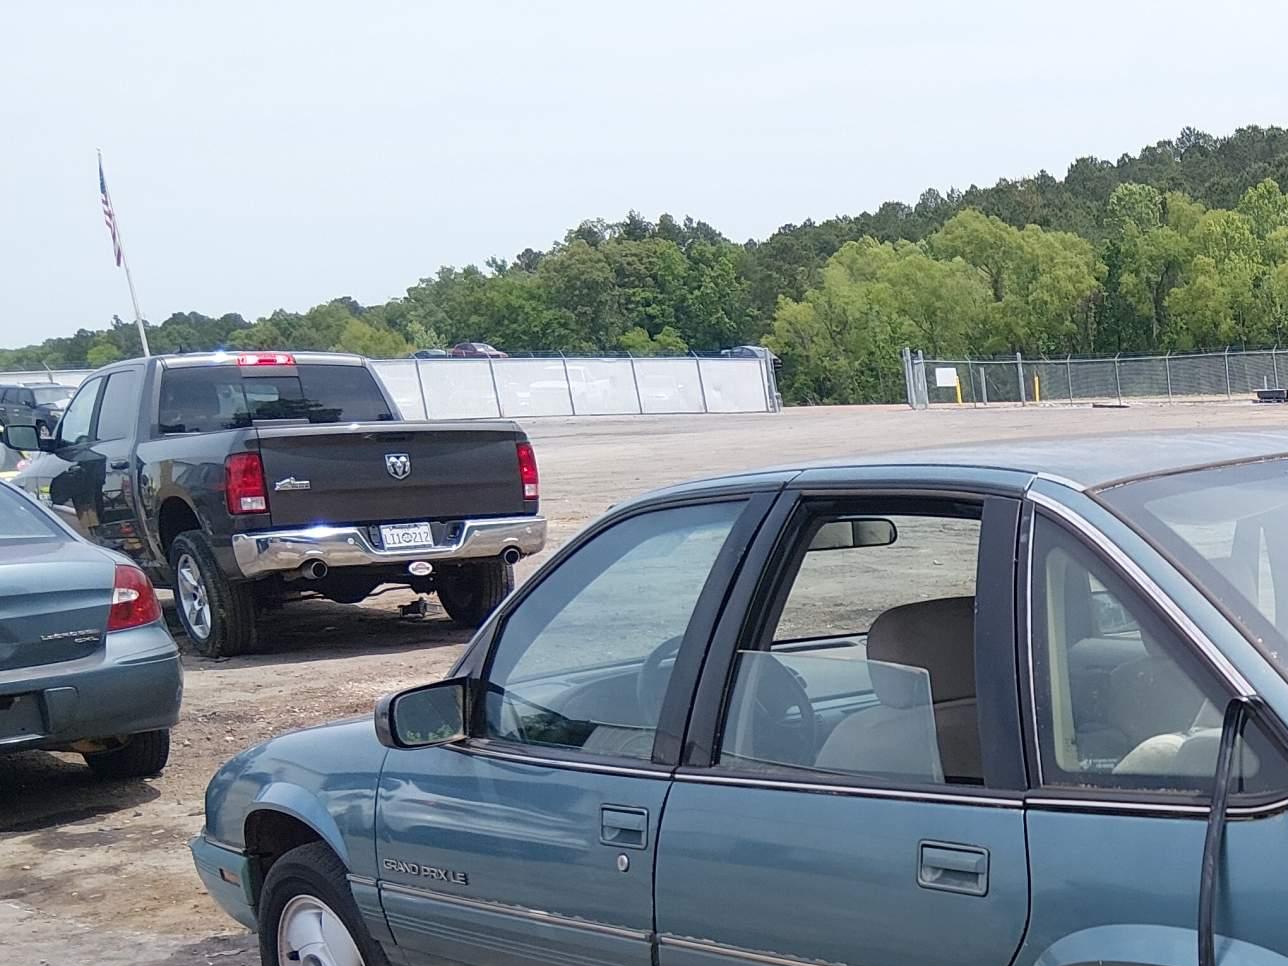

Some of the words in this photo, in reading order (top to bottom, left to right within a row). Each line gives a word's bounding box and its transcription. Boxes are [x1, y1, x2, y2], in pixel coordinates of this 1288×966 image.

[383, 858, 419, 875] GRAND
[421, 866, 448, 881] PRIX
[450, 871, 467, 886] LE
